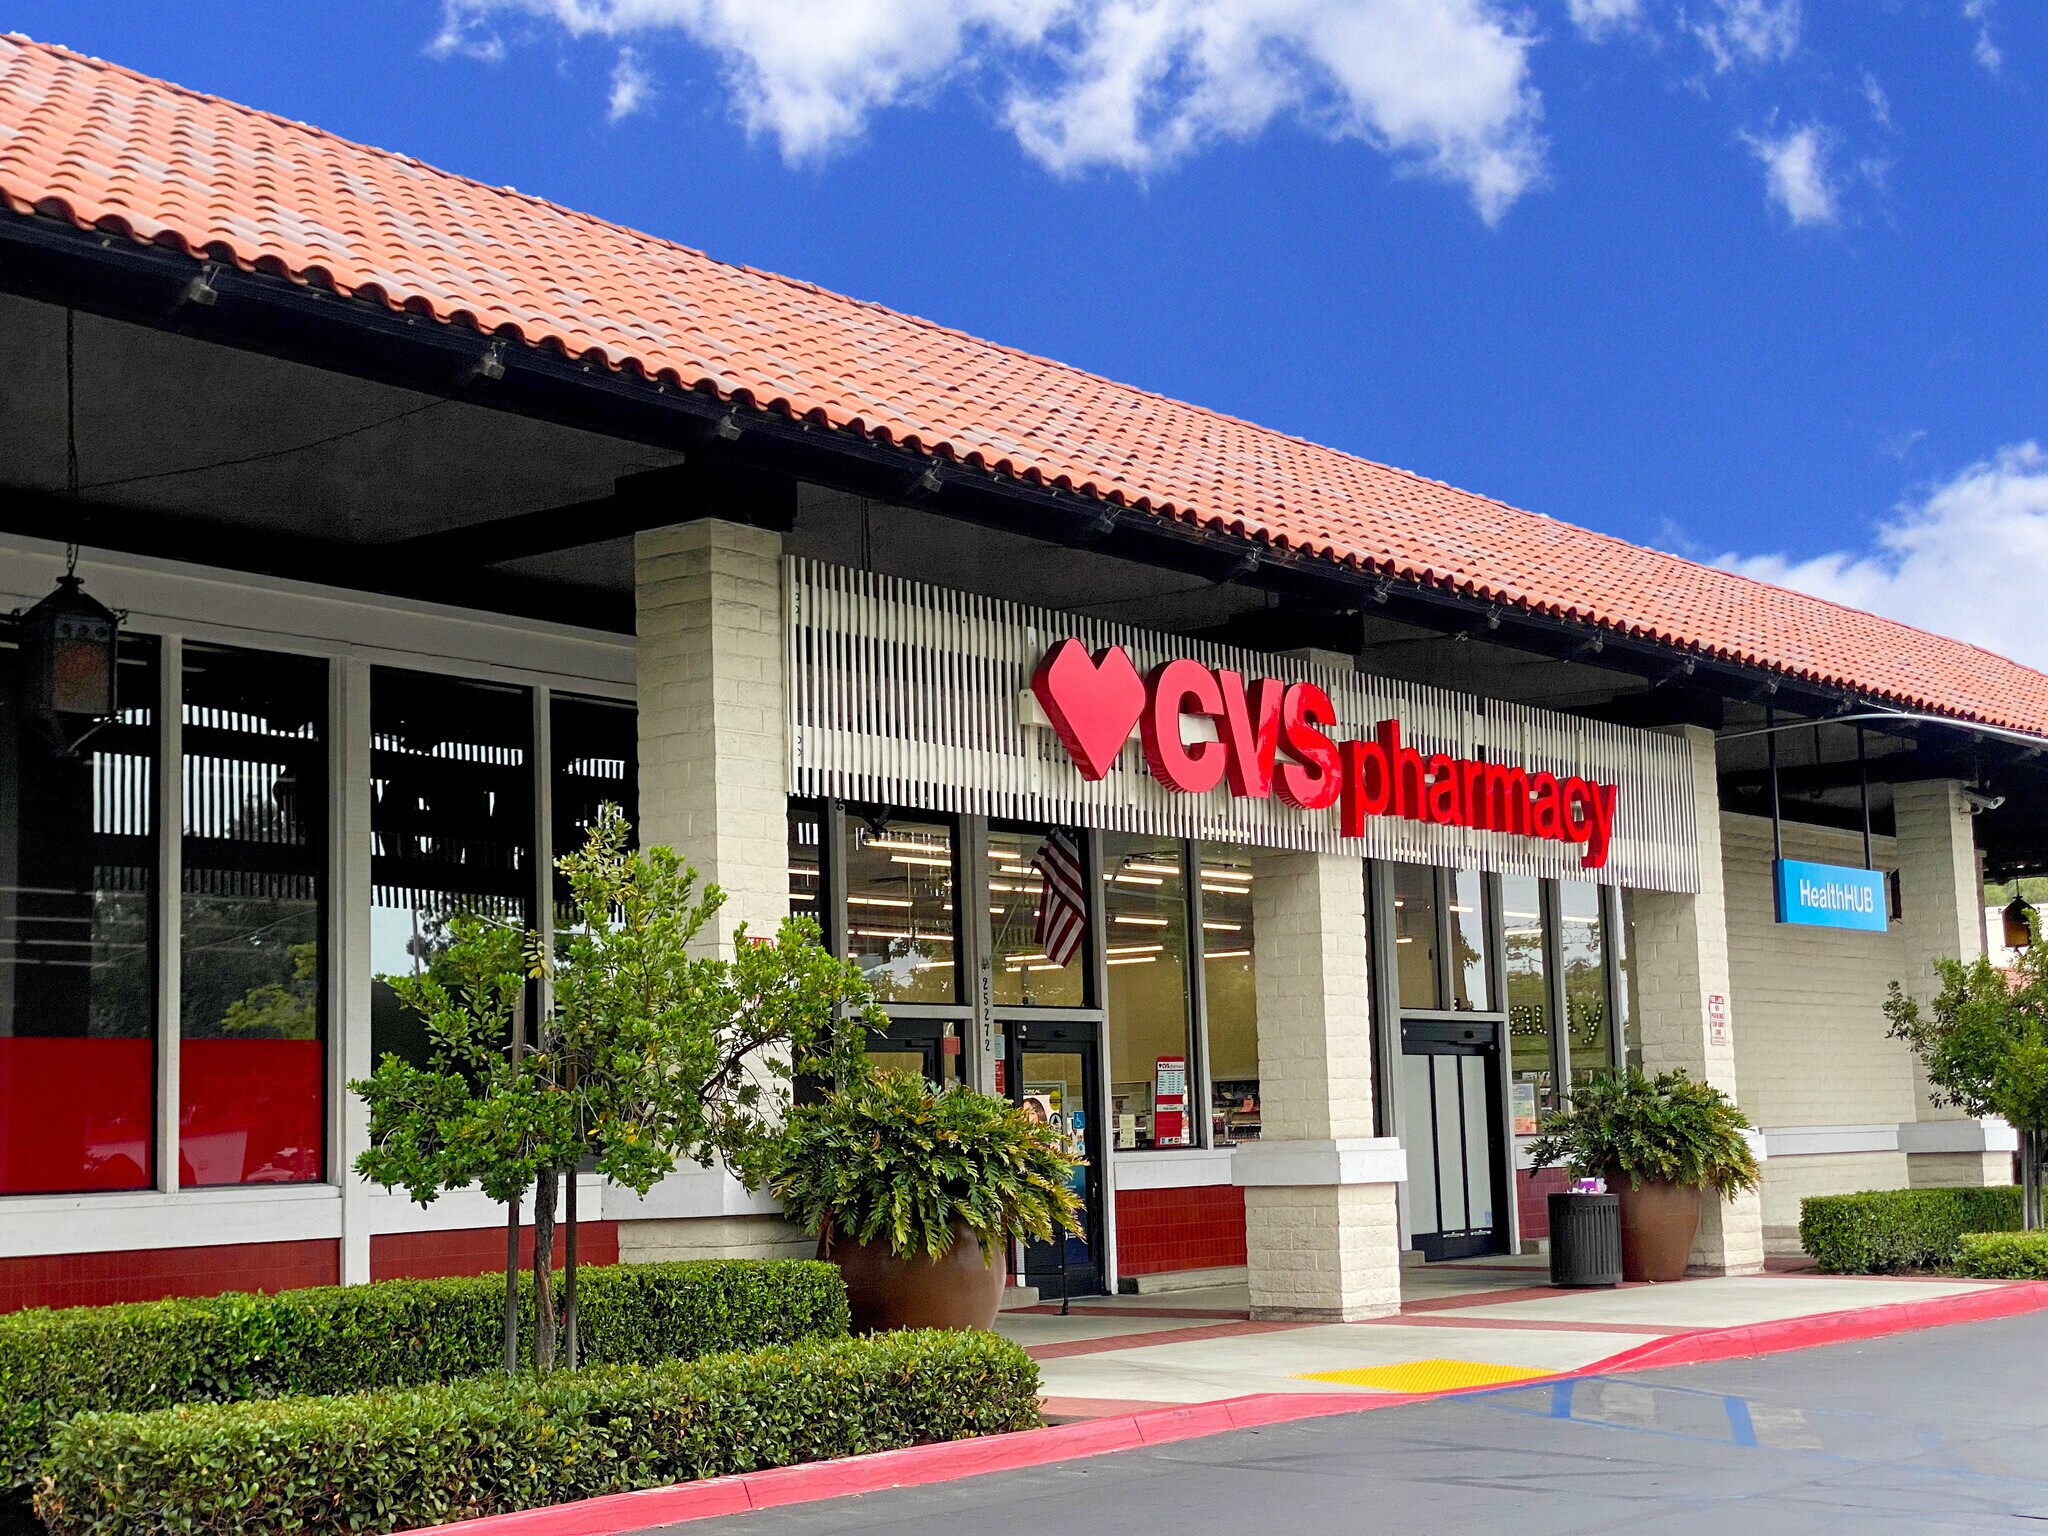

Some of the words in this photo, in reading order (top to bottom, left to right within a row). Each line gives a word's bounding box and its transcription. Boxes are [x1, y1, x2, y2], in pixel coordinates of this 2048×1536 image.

[1140, 658, 1343, 810] CVS
[1339, 719, 1617, 869] pharmacy
[1799, 878, 1874, 914] HealthHUB
[982, 977, 990, 1052] 25272
